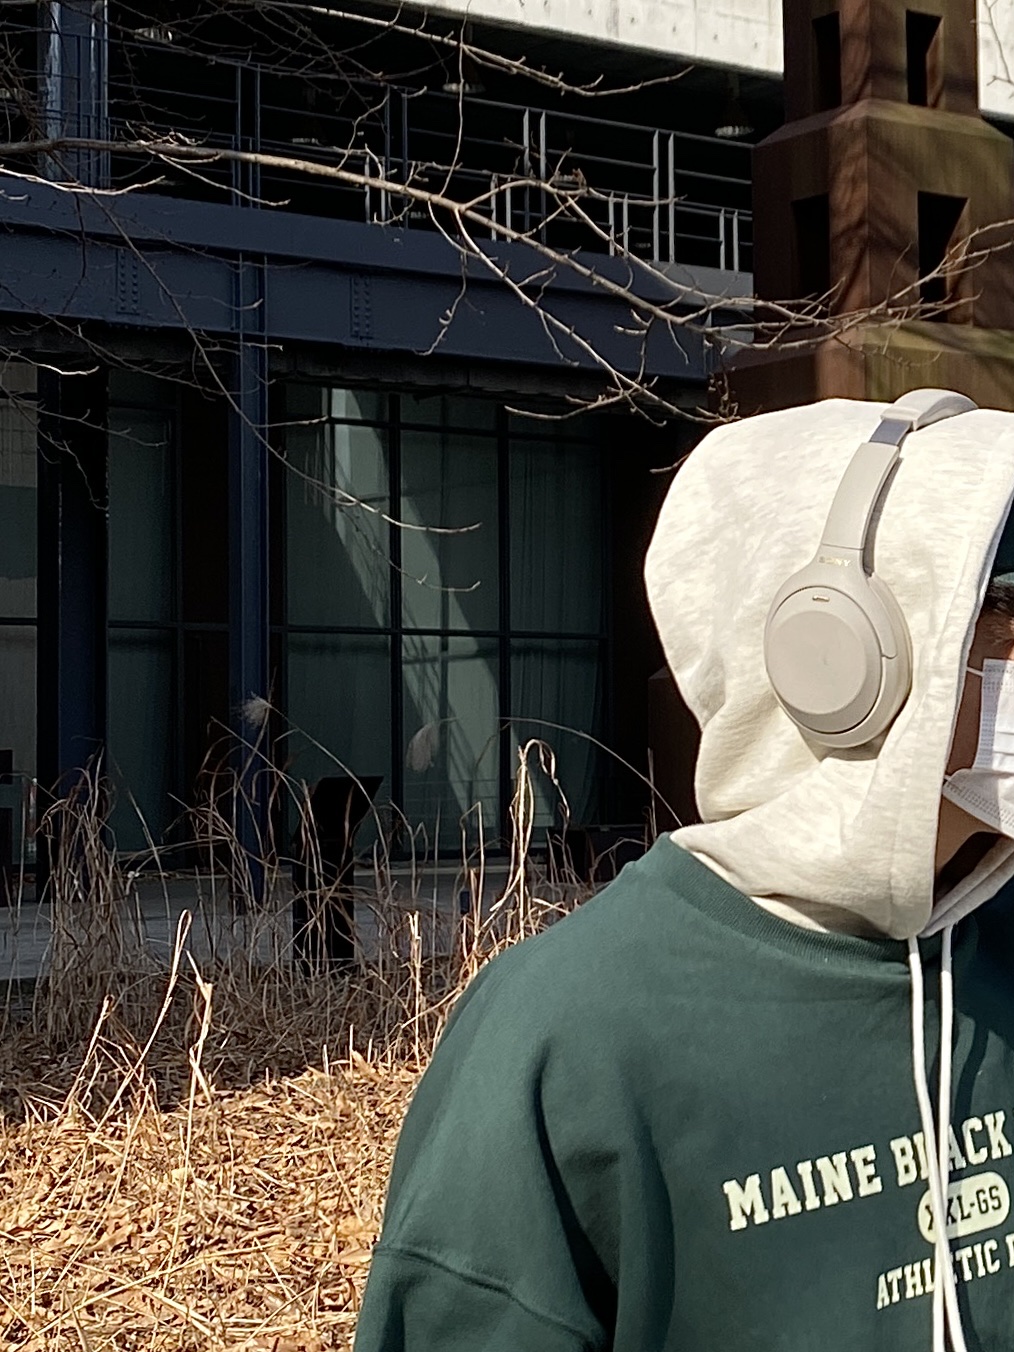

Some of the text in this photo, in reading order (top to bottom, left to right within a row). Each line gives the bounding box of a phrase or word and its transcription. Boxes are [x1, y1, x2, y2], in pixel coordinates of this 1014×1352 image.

[722, 1143, 883, 1232] MAINE
[890, 1109, 1013, 1187] BLACK
[876, 1238, 1001, 1311] ATHLTIC
